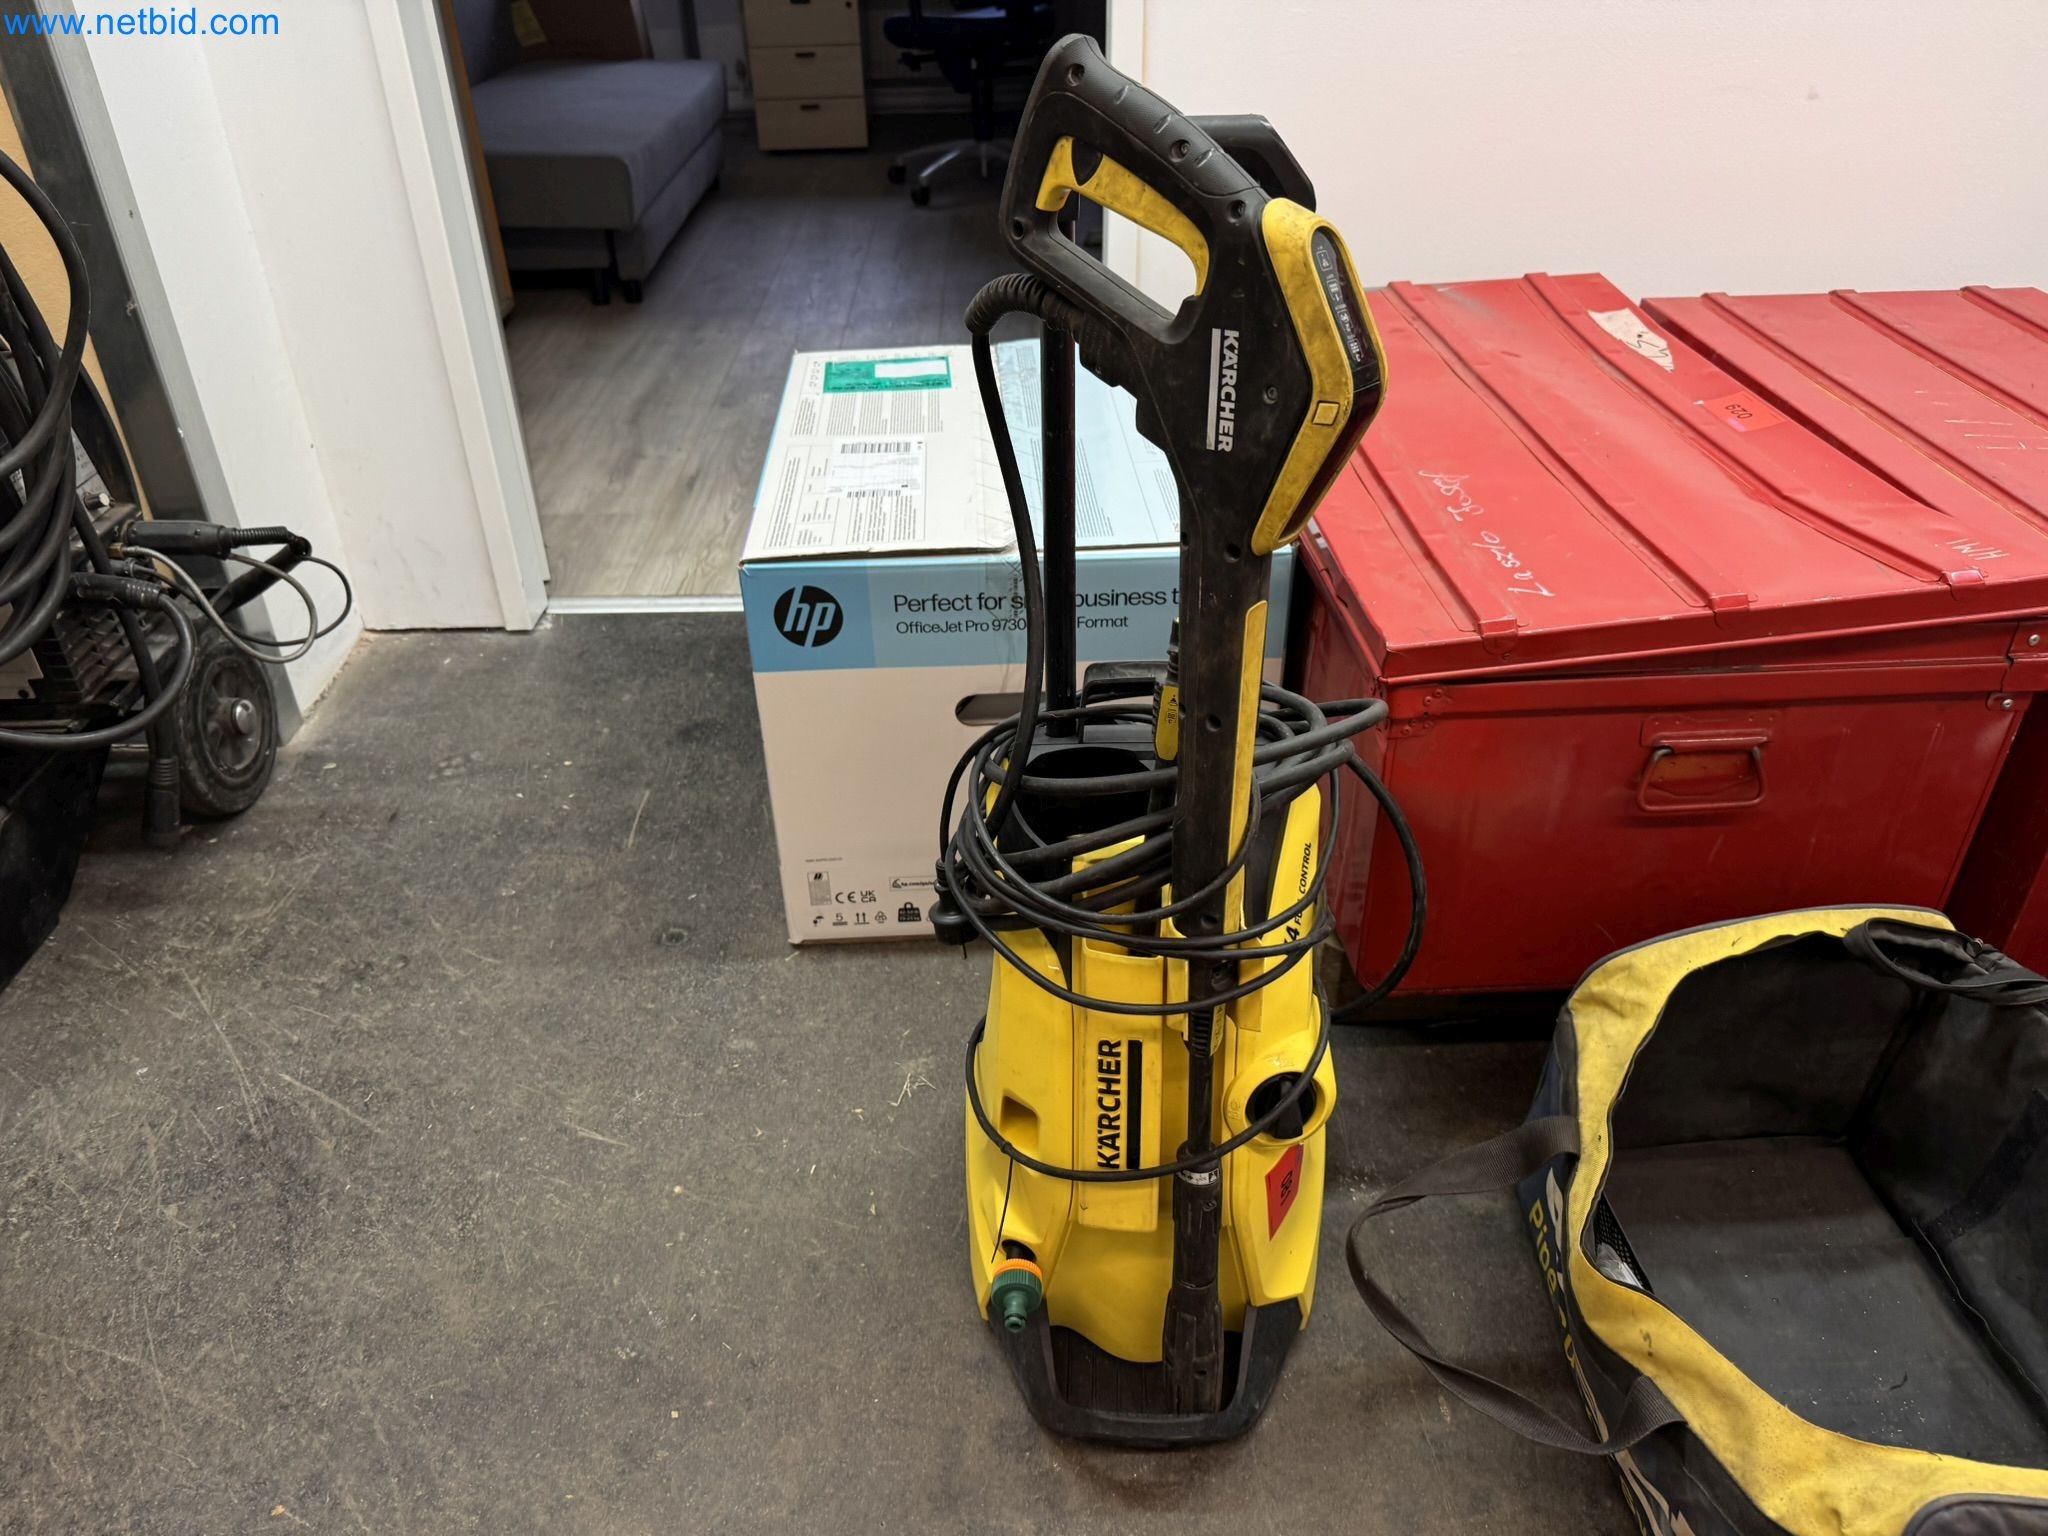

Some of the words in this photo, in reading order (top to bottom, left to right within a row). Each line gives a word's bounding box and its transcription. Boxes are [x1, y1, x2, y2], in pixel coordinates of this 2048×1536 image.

[1218, 329, 1240, 452] KÄRCHER
[1726, 403, 1753, 420] 029
[780, 586, 839, 647] hp
[894, 593, 973, 612] Perfect
[977, 592, 1006, 611] for
[896, 621, 963, 634] OfficeJet
[965, 620, 989, 632] Pro
[991, 618, 1027, 632] 9730
[1077, 616, 1129, 629] Format
[1299, 842, 1312, 894] CONTROL
[1097, 1040, 1121, 1170] KÄRCHER
